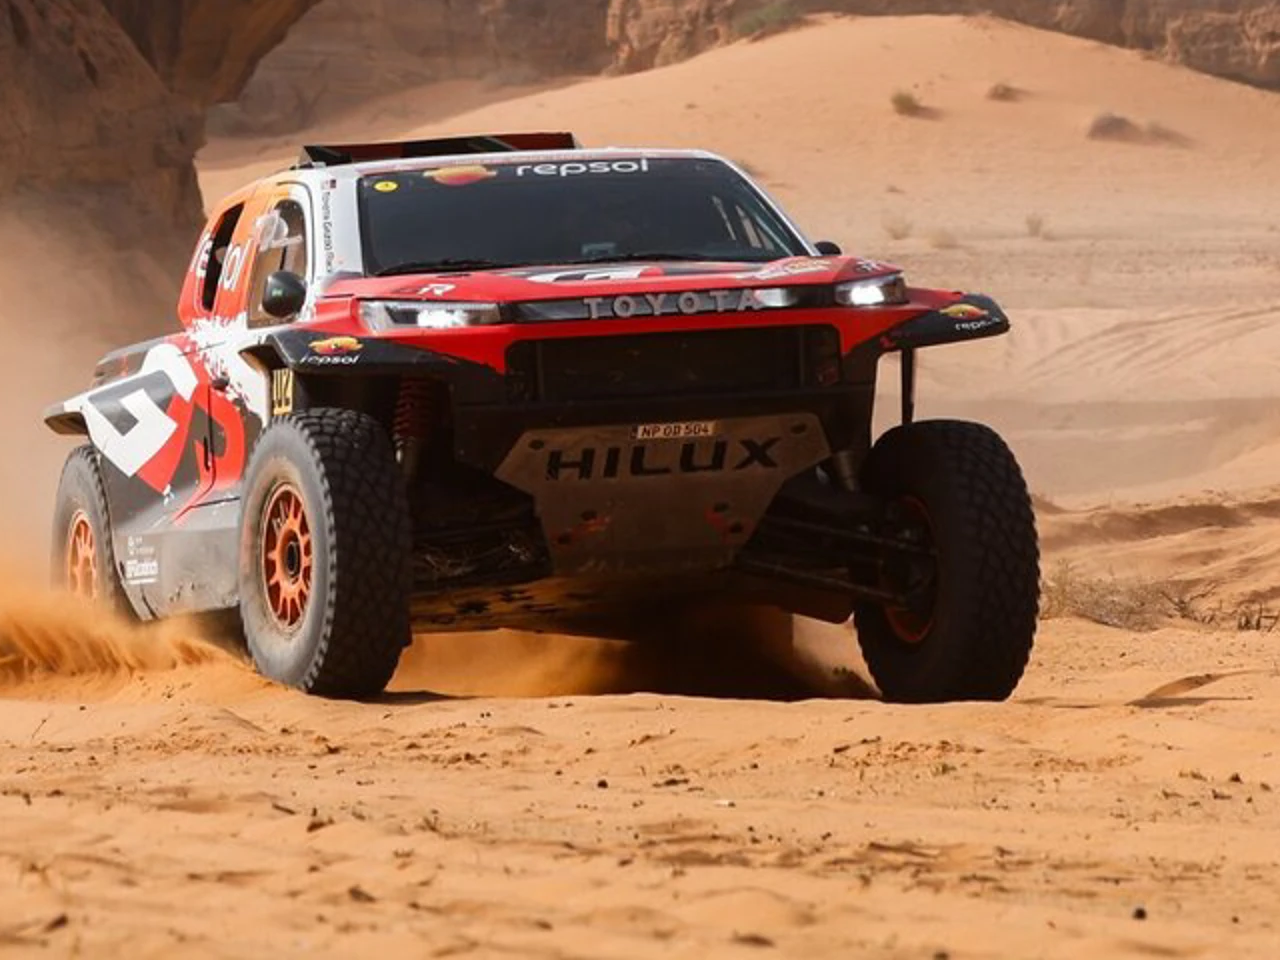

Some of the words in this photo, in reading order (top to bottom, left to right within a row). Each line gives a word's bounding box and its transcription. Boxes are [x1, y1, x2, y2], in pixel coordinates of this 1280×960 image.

[516, 158, 649, 177] repsol
[583, 290, 761, 320] TOYOTA
[546, 436, 780, 480] HILUX
